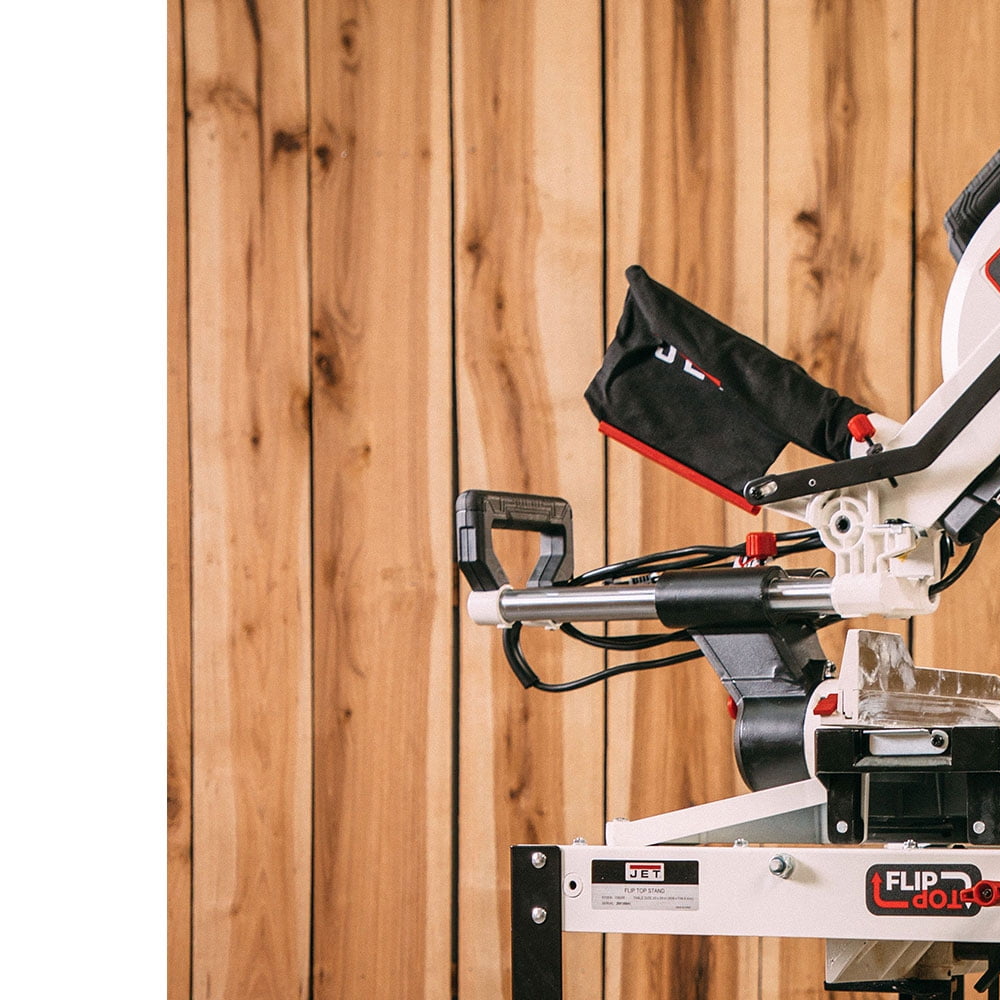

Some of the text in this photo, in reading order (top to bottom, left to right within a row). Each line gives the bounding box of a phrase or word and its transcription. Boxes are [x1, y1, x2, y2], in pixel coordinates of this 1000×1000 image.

[629, 869, 661, 878] JET
[886, 871, 938, 891] FLIP
[912, 889, 963, 909] TOP
